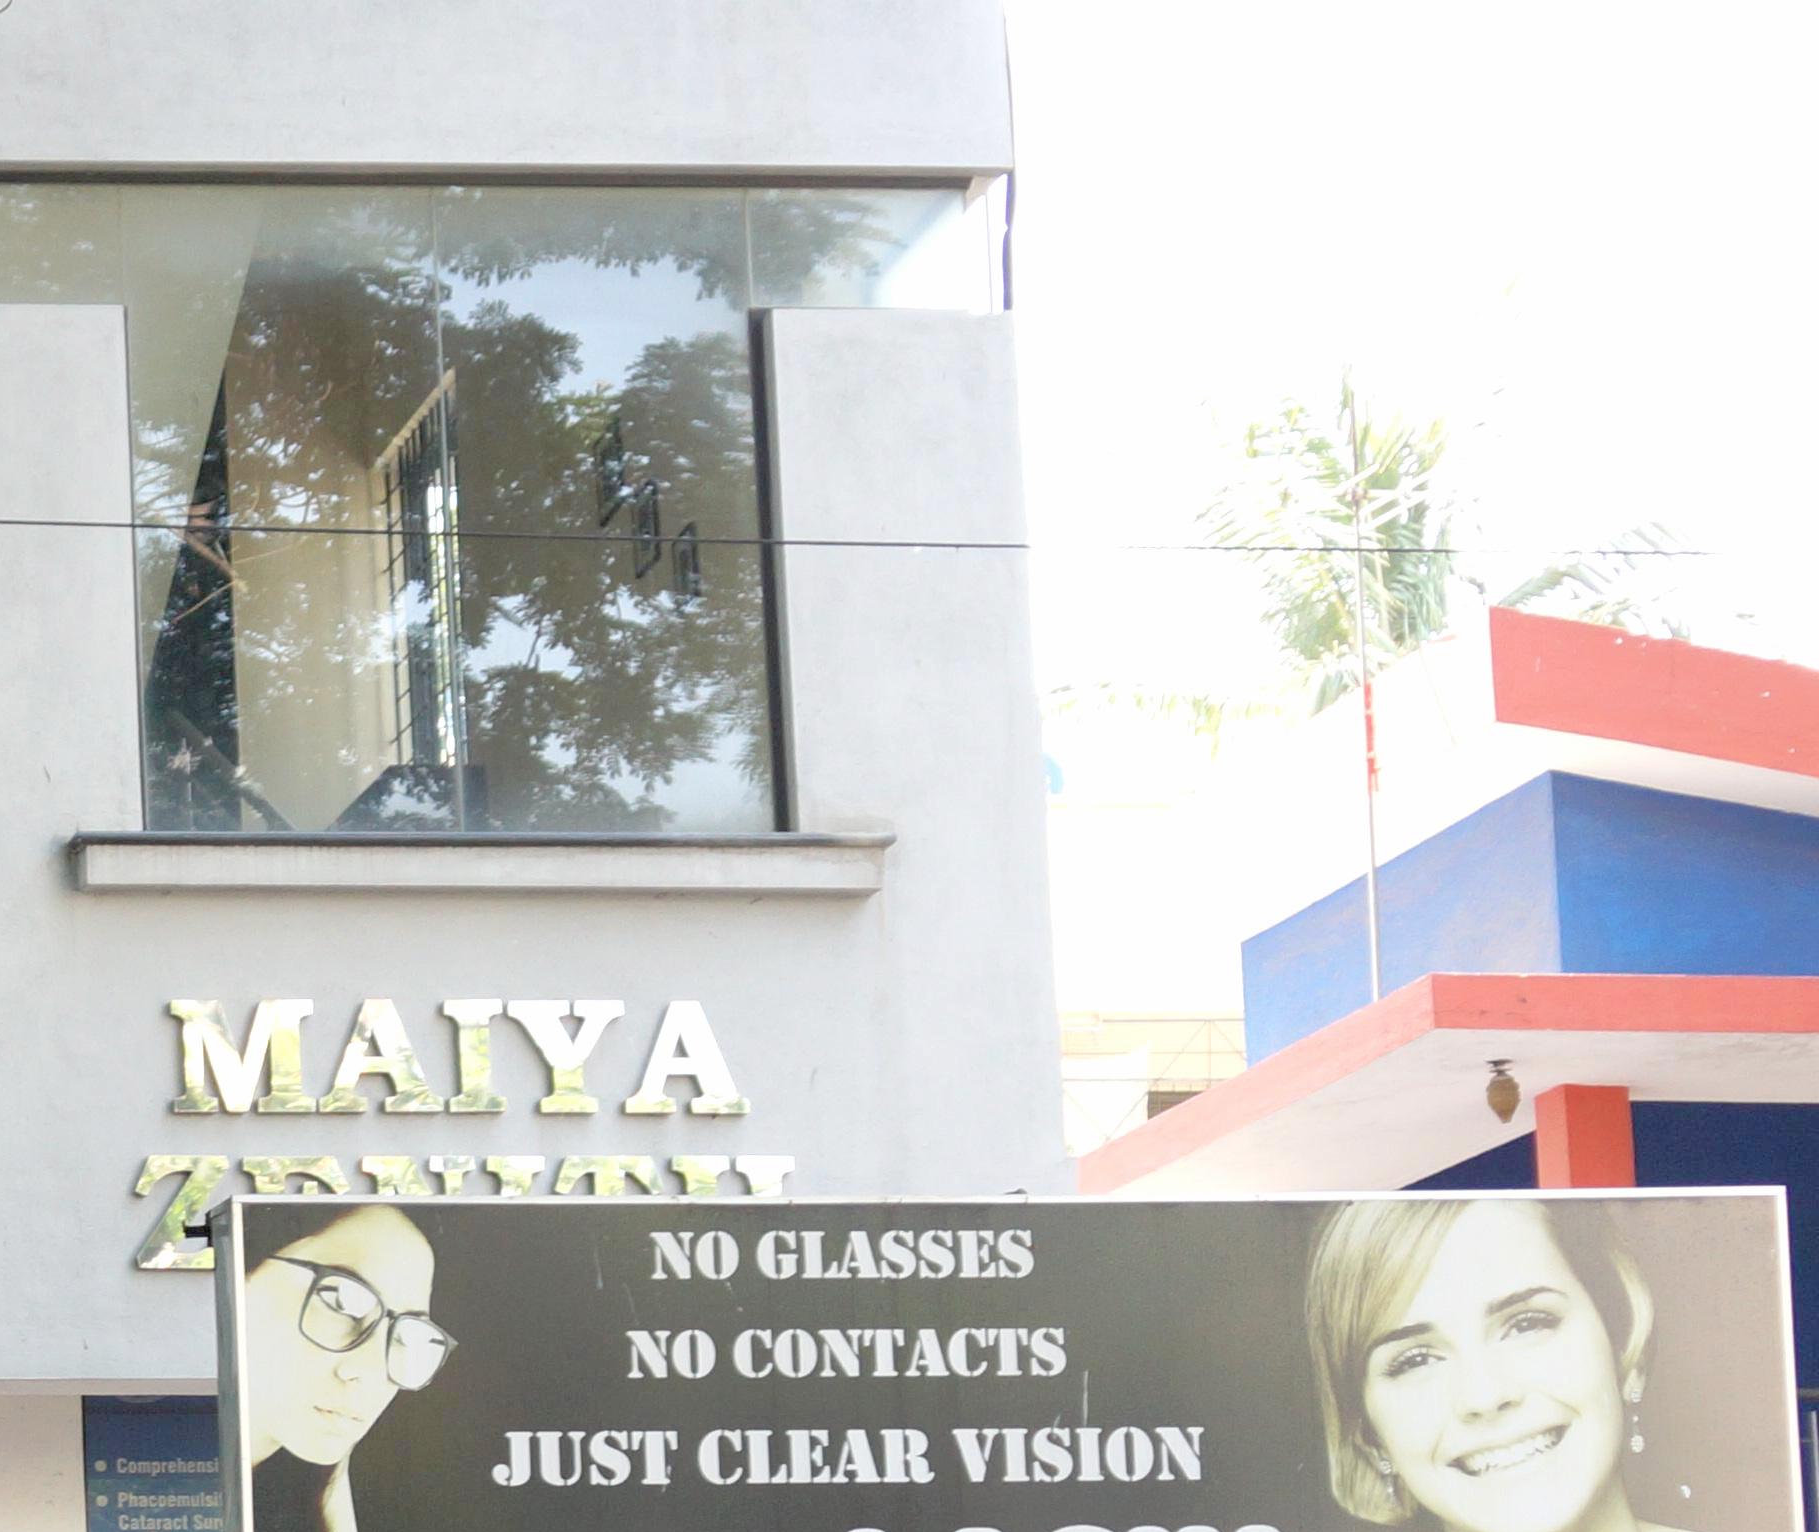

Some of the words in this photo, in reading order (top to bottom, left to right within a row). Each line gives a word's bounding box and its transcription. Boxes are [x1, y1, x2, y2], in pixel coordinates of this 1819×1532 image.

[167, 998, 752, 1115] MAIYA
[649, 1231, 740, 1280] NO
[757, 1228, 1036, 1280] GLASSES
[625, 1329, 717, 1380] NO
[733, 1326, 1068, 1379] CONTACTS
[491, 1429, 680, 1488] JUST
[696, 1428, 936, 1486] CLEAR
[951, 1425, 1206, 1484] VISION
[117, 1513, 189, 1531] Cataract
